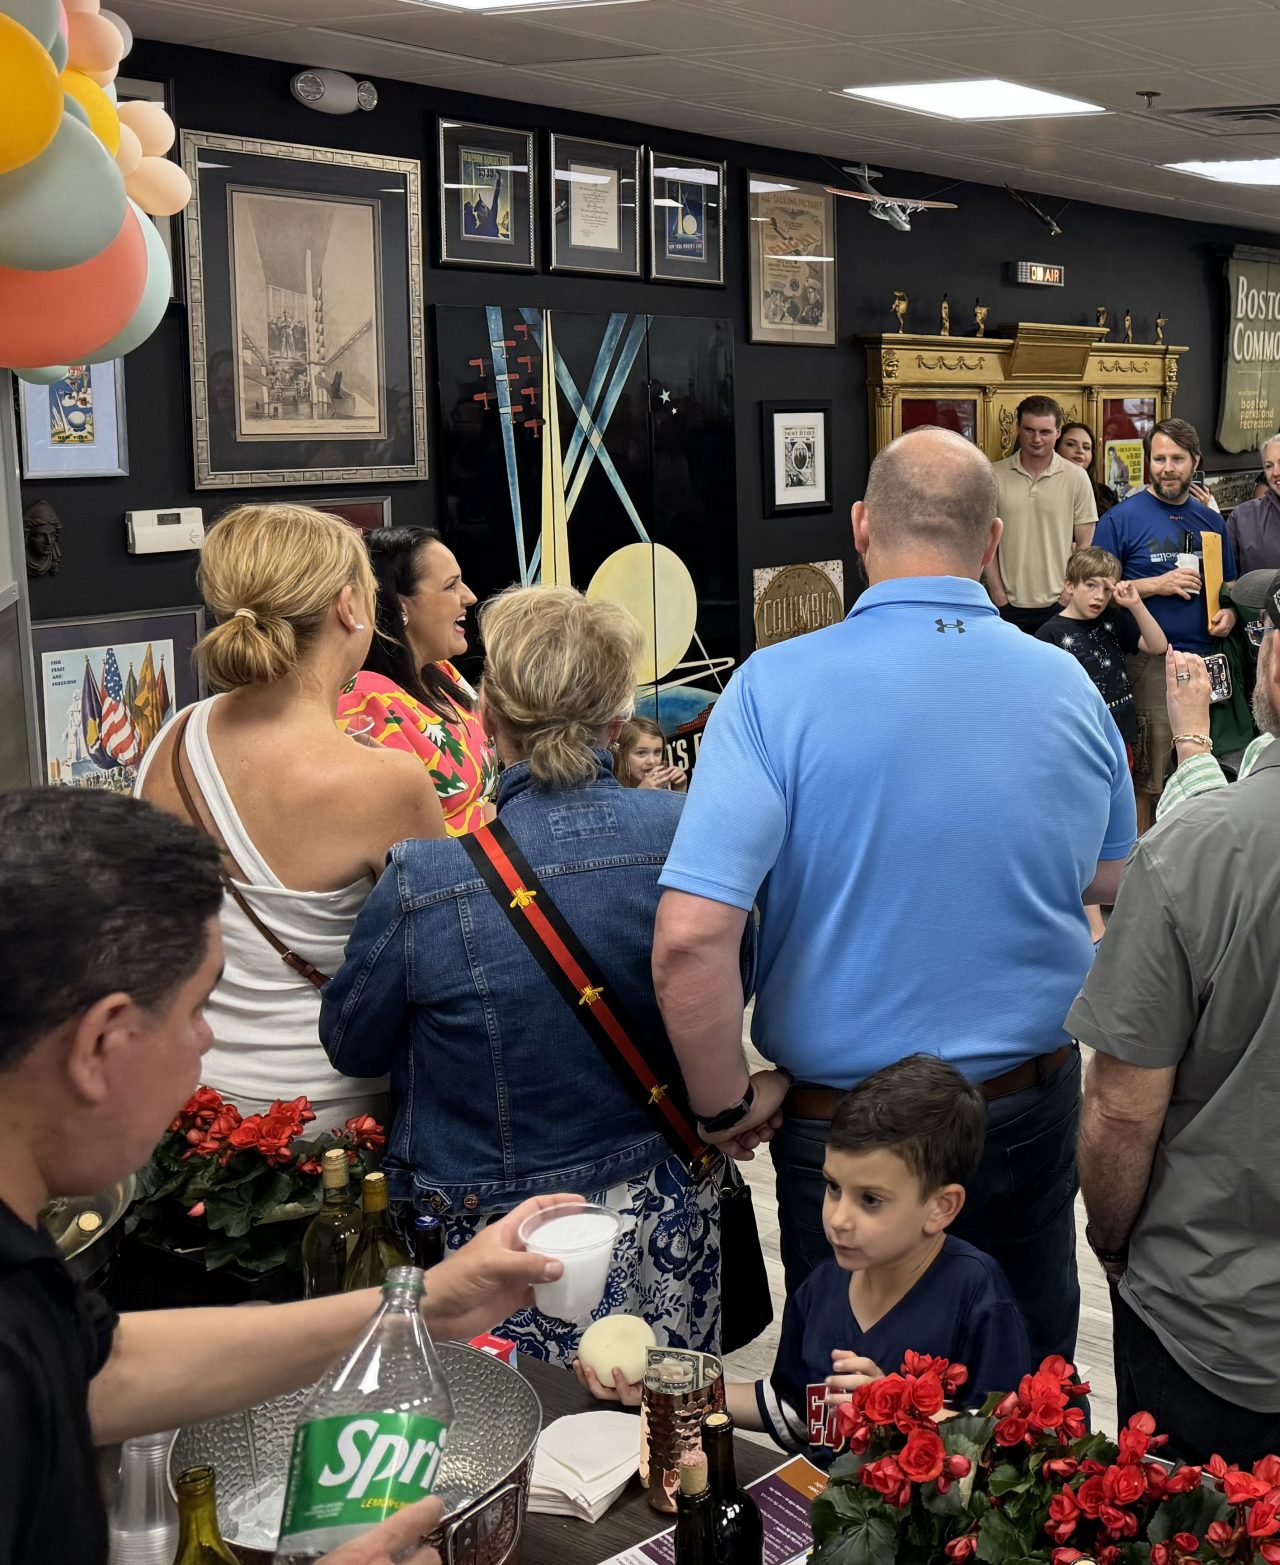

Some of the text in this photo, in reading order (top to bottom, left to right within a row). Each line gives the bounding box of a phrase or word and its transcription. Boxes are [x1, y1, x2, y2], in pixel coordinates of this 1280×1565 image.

[1044, 268, 1060, 282] AIR
[1240, 397, 1268, 409] boston
[1240, 408, 1274, 421] parks and
[1239, 418, 1273, 429] recreation
[764, 591, 834, 636] COLUMBIA
[318, 1419, 447, 1500] Spri
